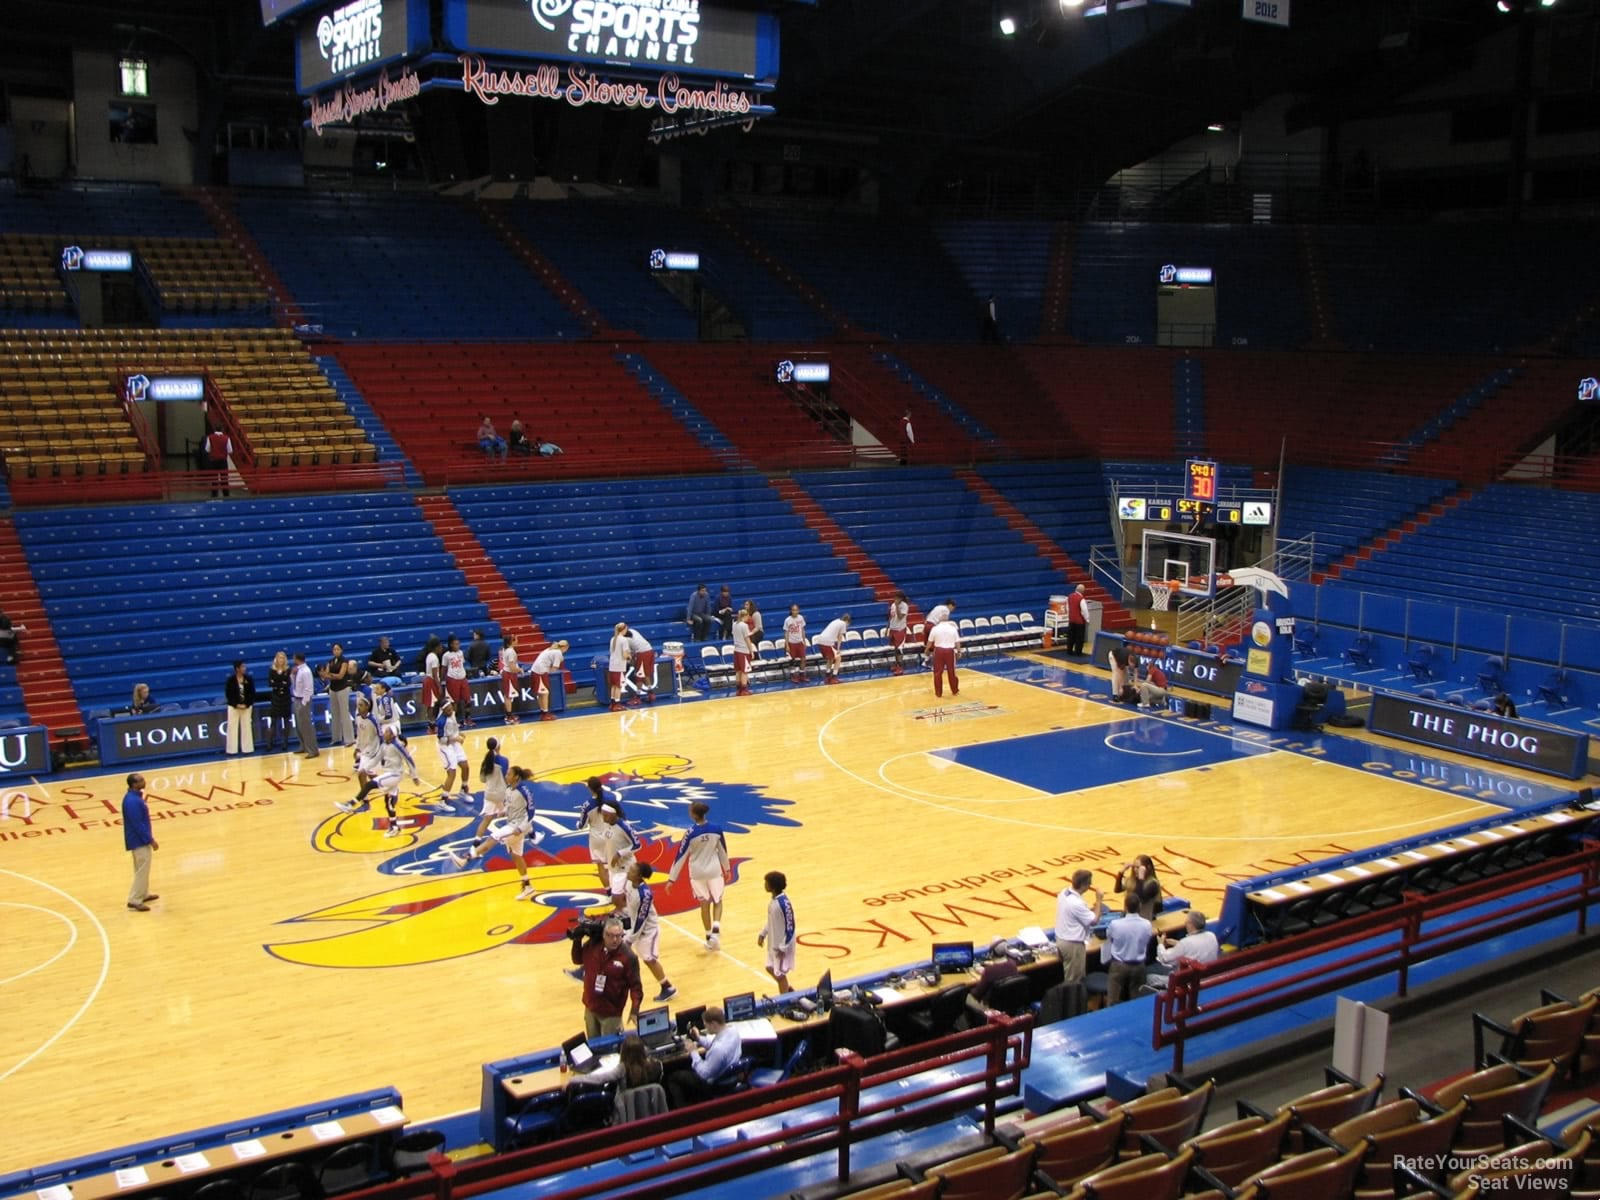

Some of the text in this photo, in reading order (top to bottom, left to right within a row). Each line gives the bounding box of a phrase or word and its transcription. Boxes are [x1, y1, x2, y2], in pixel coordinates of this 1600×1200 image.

[570, 0, 700, 45] SPORTS
[1255, 1, 1278, 19] 2012
[331, 3, 382, 56] SPORTS
[331, 39, 380, 74] CHANNEL
[567, 33, 694, 64] CHANNEL
[458, 53, 750, 113] Russell Stover Candies
[310, 90, 344, 137] Russell
[1190, 463, 1214, 476] 54:01
[1192, 477, 1211, 498] 30
[1160, 507, 1169, 520] 0
[1229, 510, 1239, 522] 0
[1193, 664, 1218, 681] OF
[124, 722, 209, 748] HOME
[1409, 710, 1538, 754] THE PHOG
[0, 733, 28, 772] U
[862, 845, 1122, 907] Allen Fieldhouse
